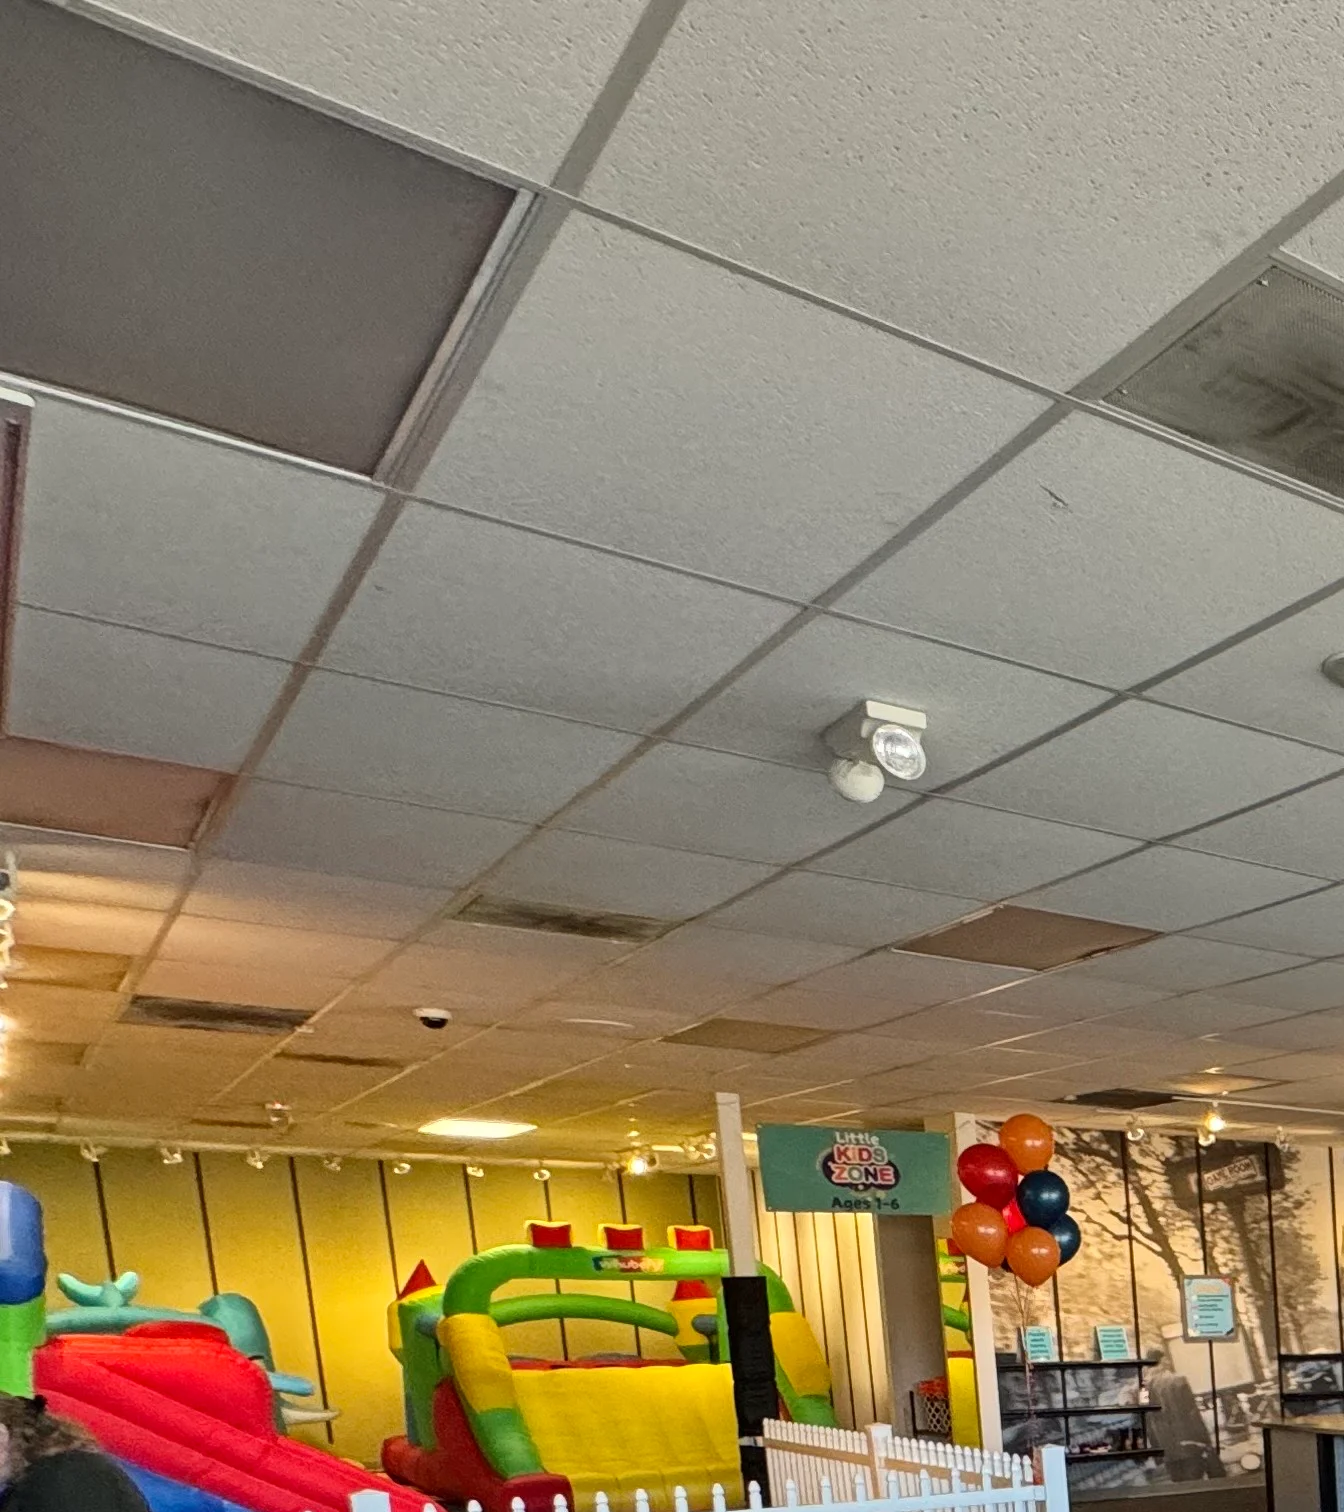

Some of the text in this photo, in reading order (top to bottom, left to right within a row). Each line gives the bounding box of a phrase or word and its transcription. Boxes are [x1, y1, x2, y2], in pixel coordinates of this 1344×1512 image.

[834, 1131, 880, 1145] Little
[833, 1144, 888, 1165] KIDS
[831, 1163, 896, 1185] ZONE
[831, 1197, 900, 1211] Ages 1-6
